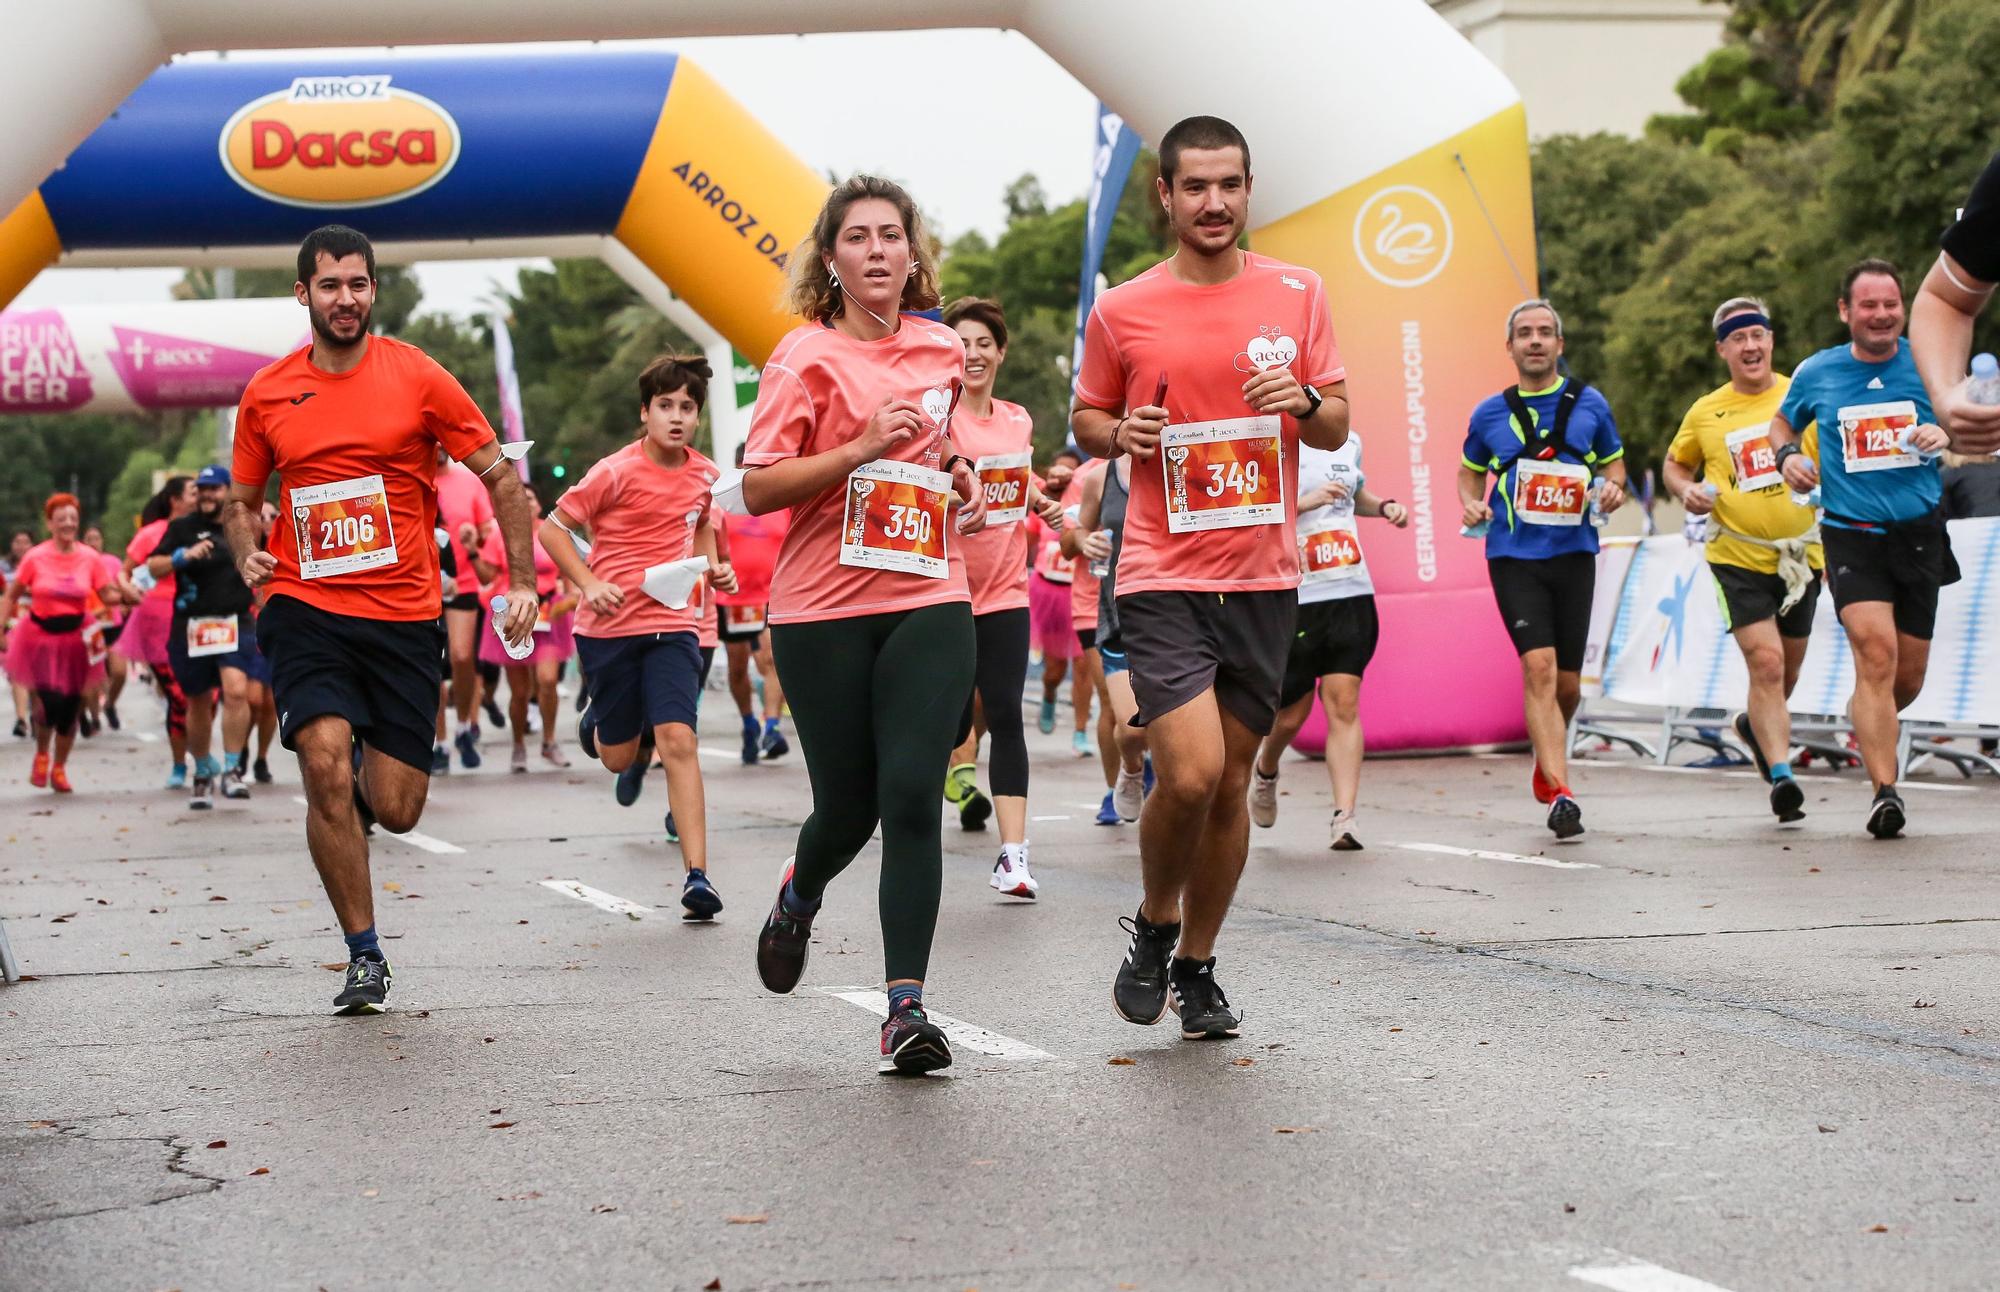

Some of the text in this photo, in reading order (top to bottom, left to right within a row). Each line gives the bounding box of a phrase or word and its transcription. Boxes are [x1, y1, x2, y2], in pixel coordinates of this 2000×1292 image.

[294, 81, 385, 98] ARROZ
[250, 120, 438, 170] Dacsa
[672, 162, 788, 271] ARROZ DA
[1, 323, 70, 349] RUN
[2, 347, 75, 378] CAN
[1255, 350, 1293, 362] aecc
[2, 377, 69, 404] CER
[1401, 320, 1428, 444] CAPUCCINI
[982, 480, 1020, 503] 1906
[1206, 460, 1259, 498] 349
[1535, 485, 1576, 508] 1345
[320, 514, 375, 550] 2106
[883, 504, 931, 544] 350
[1411, 463, 1437, 583] GERMAINE
[1315, 540, 1354, 564] 1844
